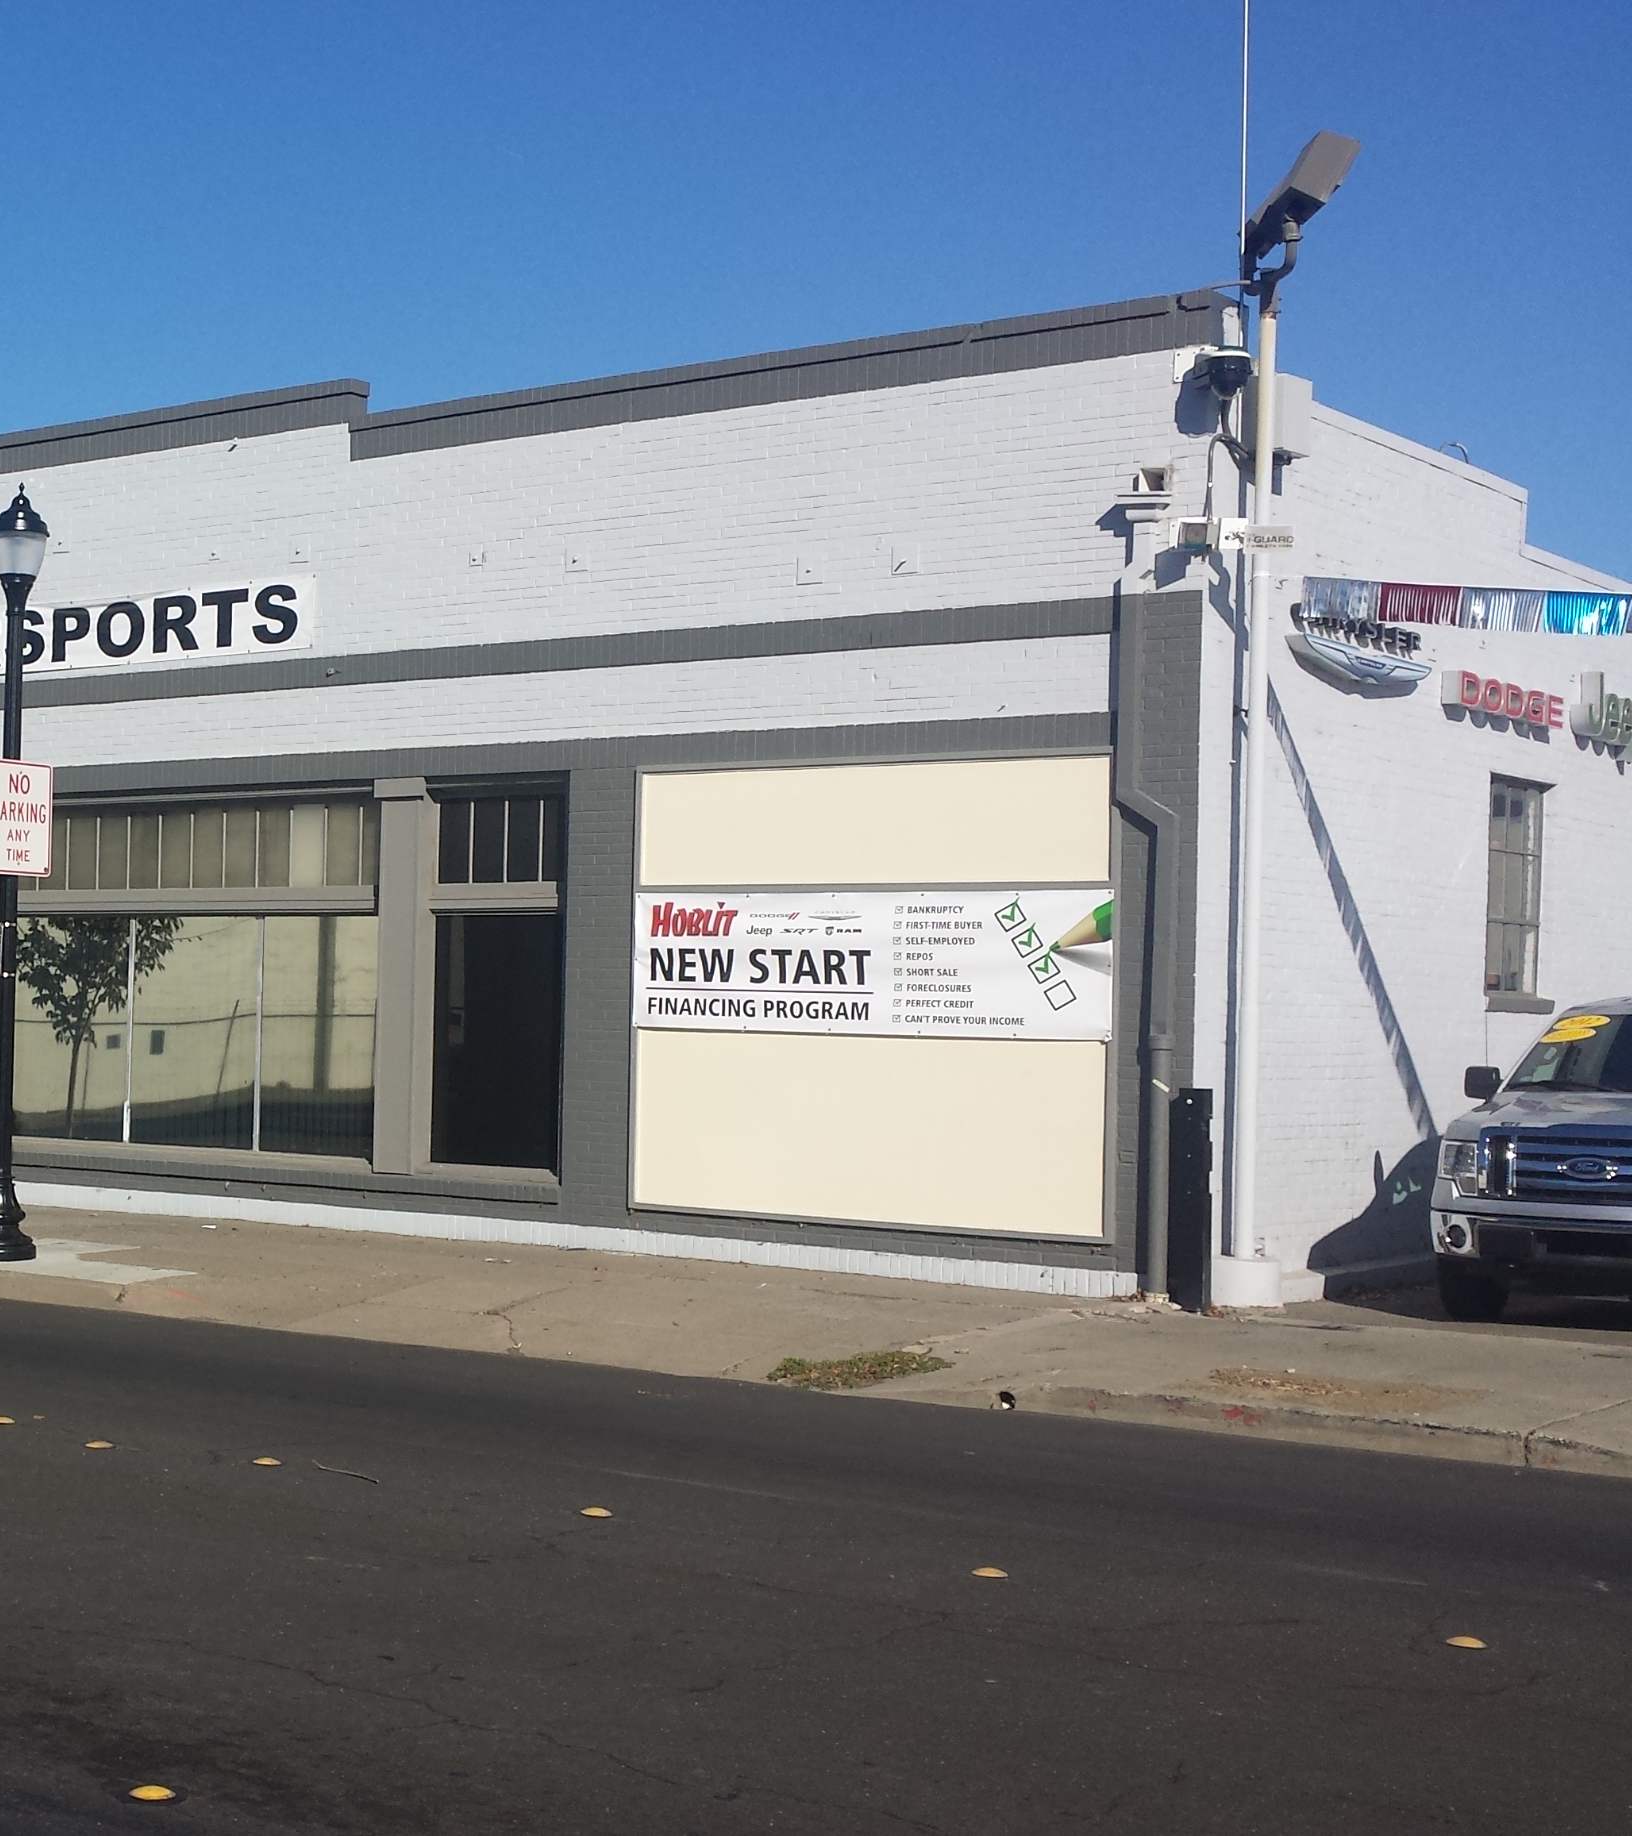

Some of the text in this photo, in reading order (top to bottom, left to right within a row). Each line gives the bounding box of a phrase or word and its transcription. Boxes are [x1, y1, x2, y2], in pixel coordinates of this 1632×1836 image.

[1458, 670, 1565, 729] DODGE
[1570, 672, 1632, 760] Jee
[8, 773, 31, 795] NO
[6, 828, 30, 842] ANY
[6, 848, 30, 862] TIME
[907, 905, 964, 914] BANKRUPTCY
[746, 925, 773, 937] Jeep
[906, 921, 983, 930] FIRST-TIME BUYER
[905, 937, 975, 945] SELF-EMPLOYED
[906, 952, 934, 961] REPOS
[650, 948, 871, 986] NEW START
[906, 968, 959, 977] SHORT SALE
[906, 984, 972, 992] FORECLOSURES
[647, 997, 870, 1021] FINANCING PROGRAM
[905, 999, 974, 1008] PERFECT CREDIT
[904, 1015, 1025, 1026] CAN'T PROVE YOUR INCOME
[1575, 1161, 1599, 1171] Ford
